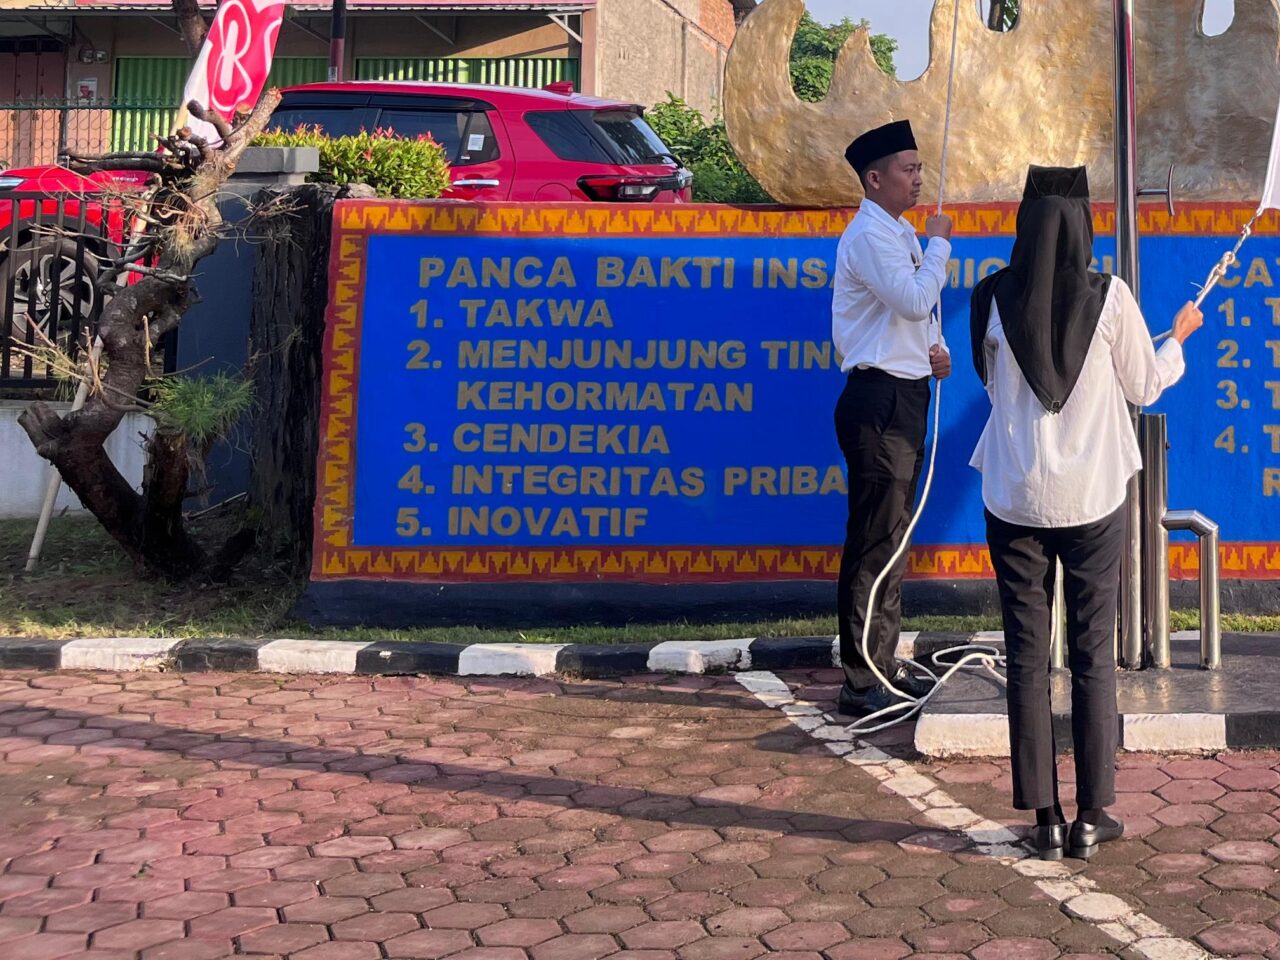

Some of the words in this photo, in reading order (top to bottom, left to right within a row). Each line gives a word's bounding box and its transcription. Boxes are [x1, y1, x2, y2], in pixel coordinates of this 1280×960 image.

[419, 256, 576, 288] PANCA
[596, 256, 735, 289] BAKTI
[753, 258, 836, 289] INS
[410, 299, 443, 328] 1.
[460, 299, 613, 328] TAKWA
[1218, 299, 1251, 327] 1.
[406, 340, 442, 369] 2.
[458, 339, 746, 369] MENJUNJUNG
[762, 340, 843, 369] TIN
[1218, 339, 1251, 368] 2.
[457, 381, 753, 411] KEHORMATAN
[1217, 380, 1250, 410] 3.
[404, 423, 437, 452] 3.
[453, 423, 669, 454] CENDEKIA
[1215, 425, 1249, 453] 4.
[398, 465, 435, 494] 4.
[452, 465, 705, 497] INTEGRITAS
[396, 507, 431, 537] 5.
[448, 506, 648, 537] INOVATIF
